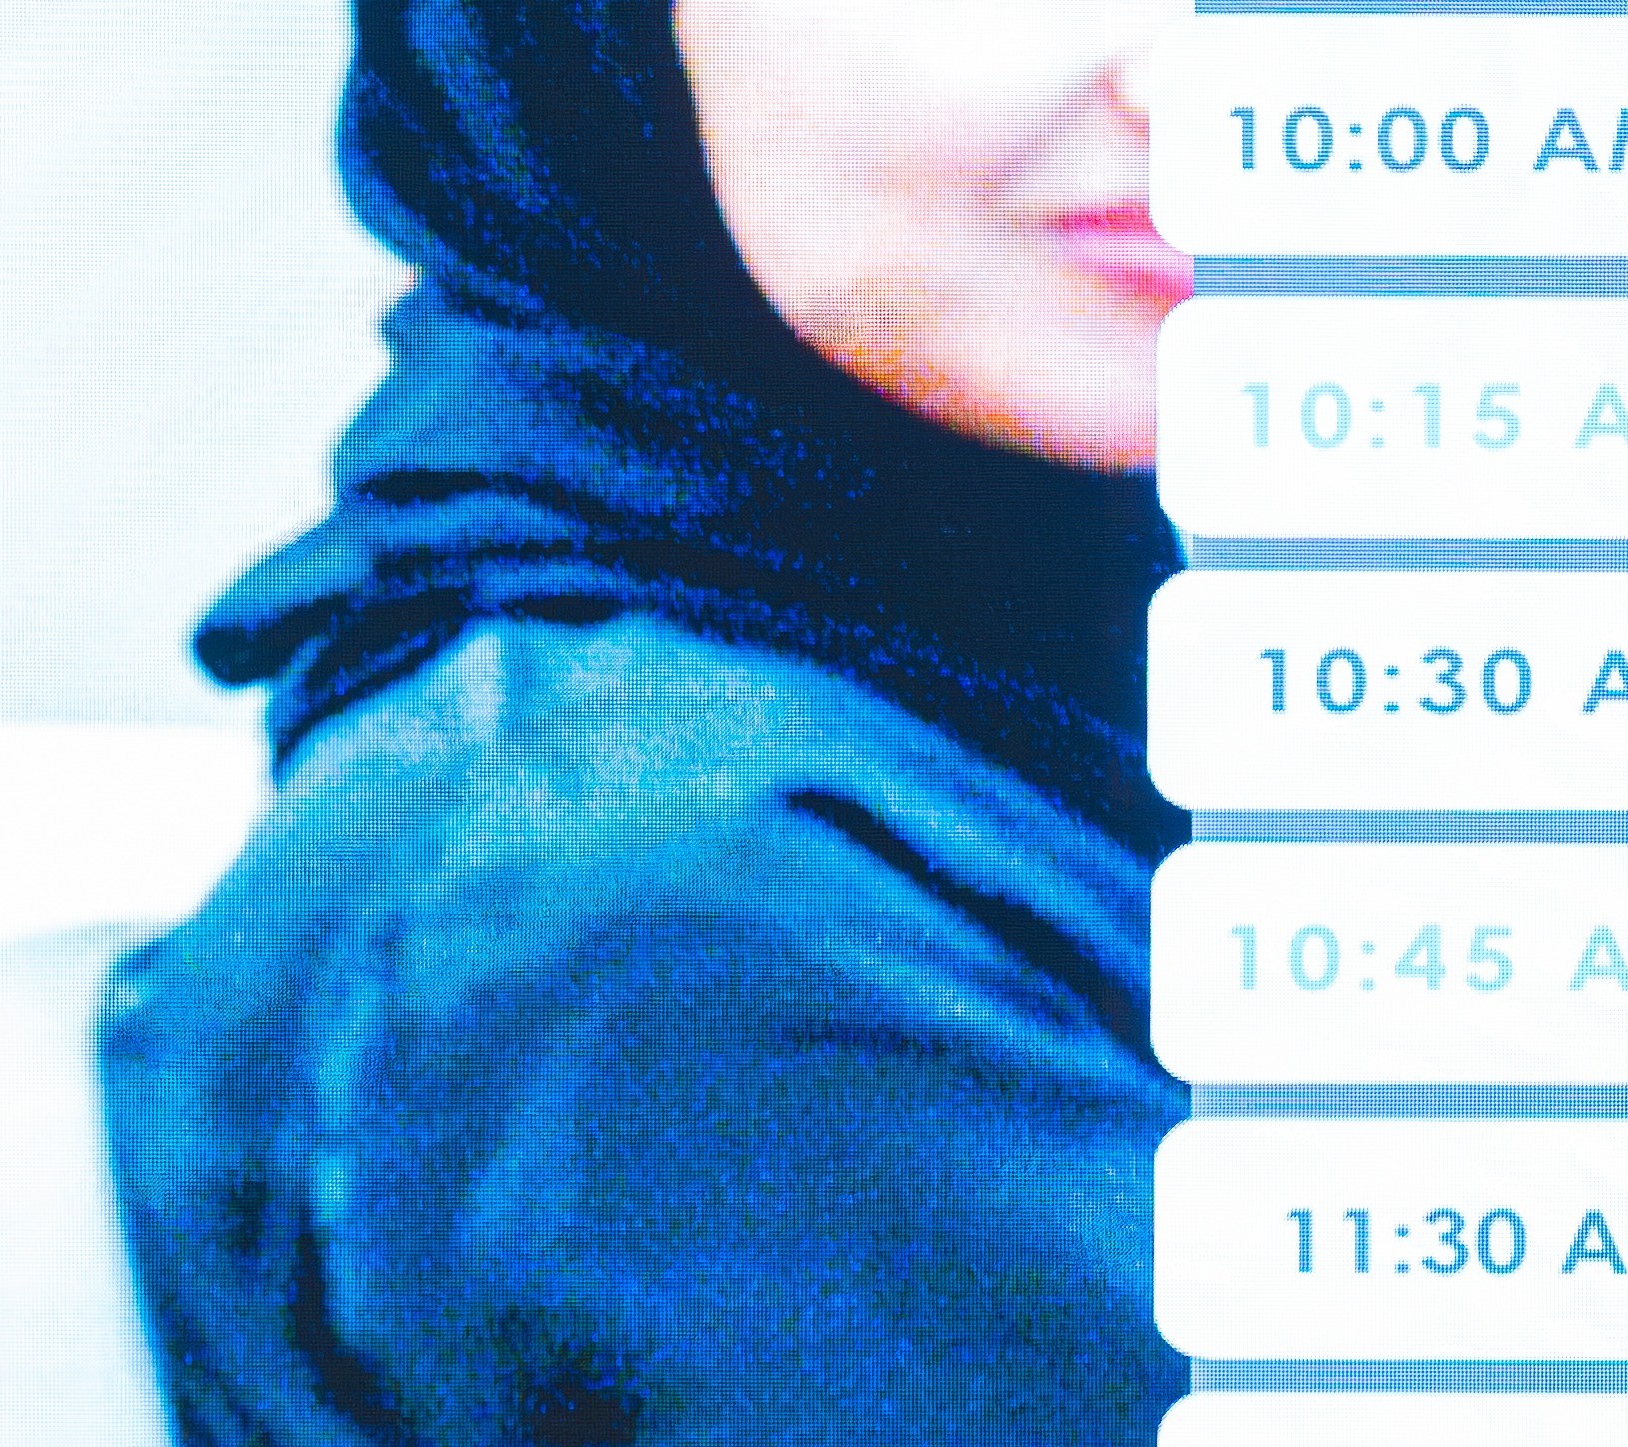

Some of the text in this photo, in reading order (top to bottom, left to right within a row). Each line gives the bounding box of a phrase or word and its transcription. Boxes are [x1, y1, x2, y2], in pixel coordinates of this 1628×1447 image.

[1228, 102, 1628, 175] 10:00 A
[1242, 380, 1522, 451] 10:15
[1257, 645, 1536, 718] 10:30
[1230, 922, 1516, 994] 10:45
[1284, 1205, 1531, 1278] 11:30
